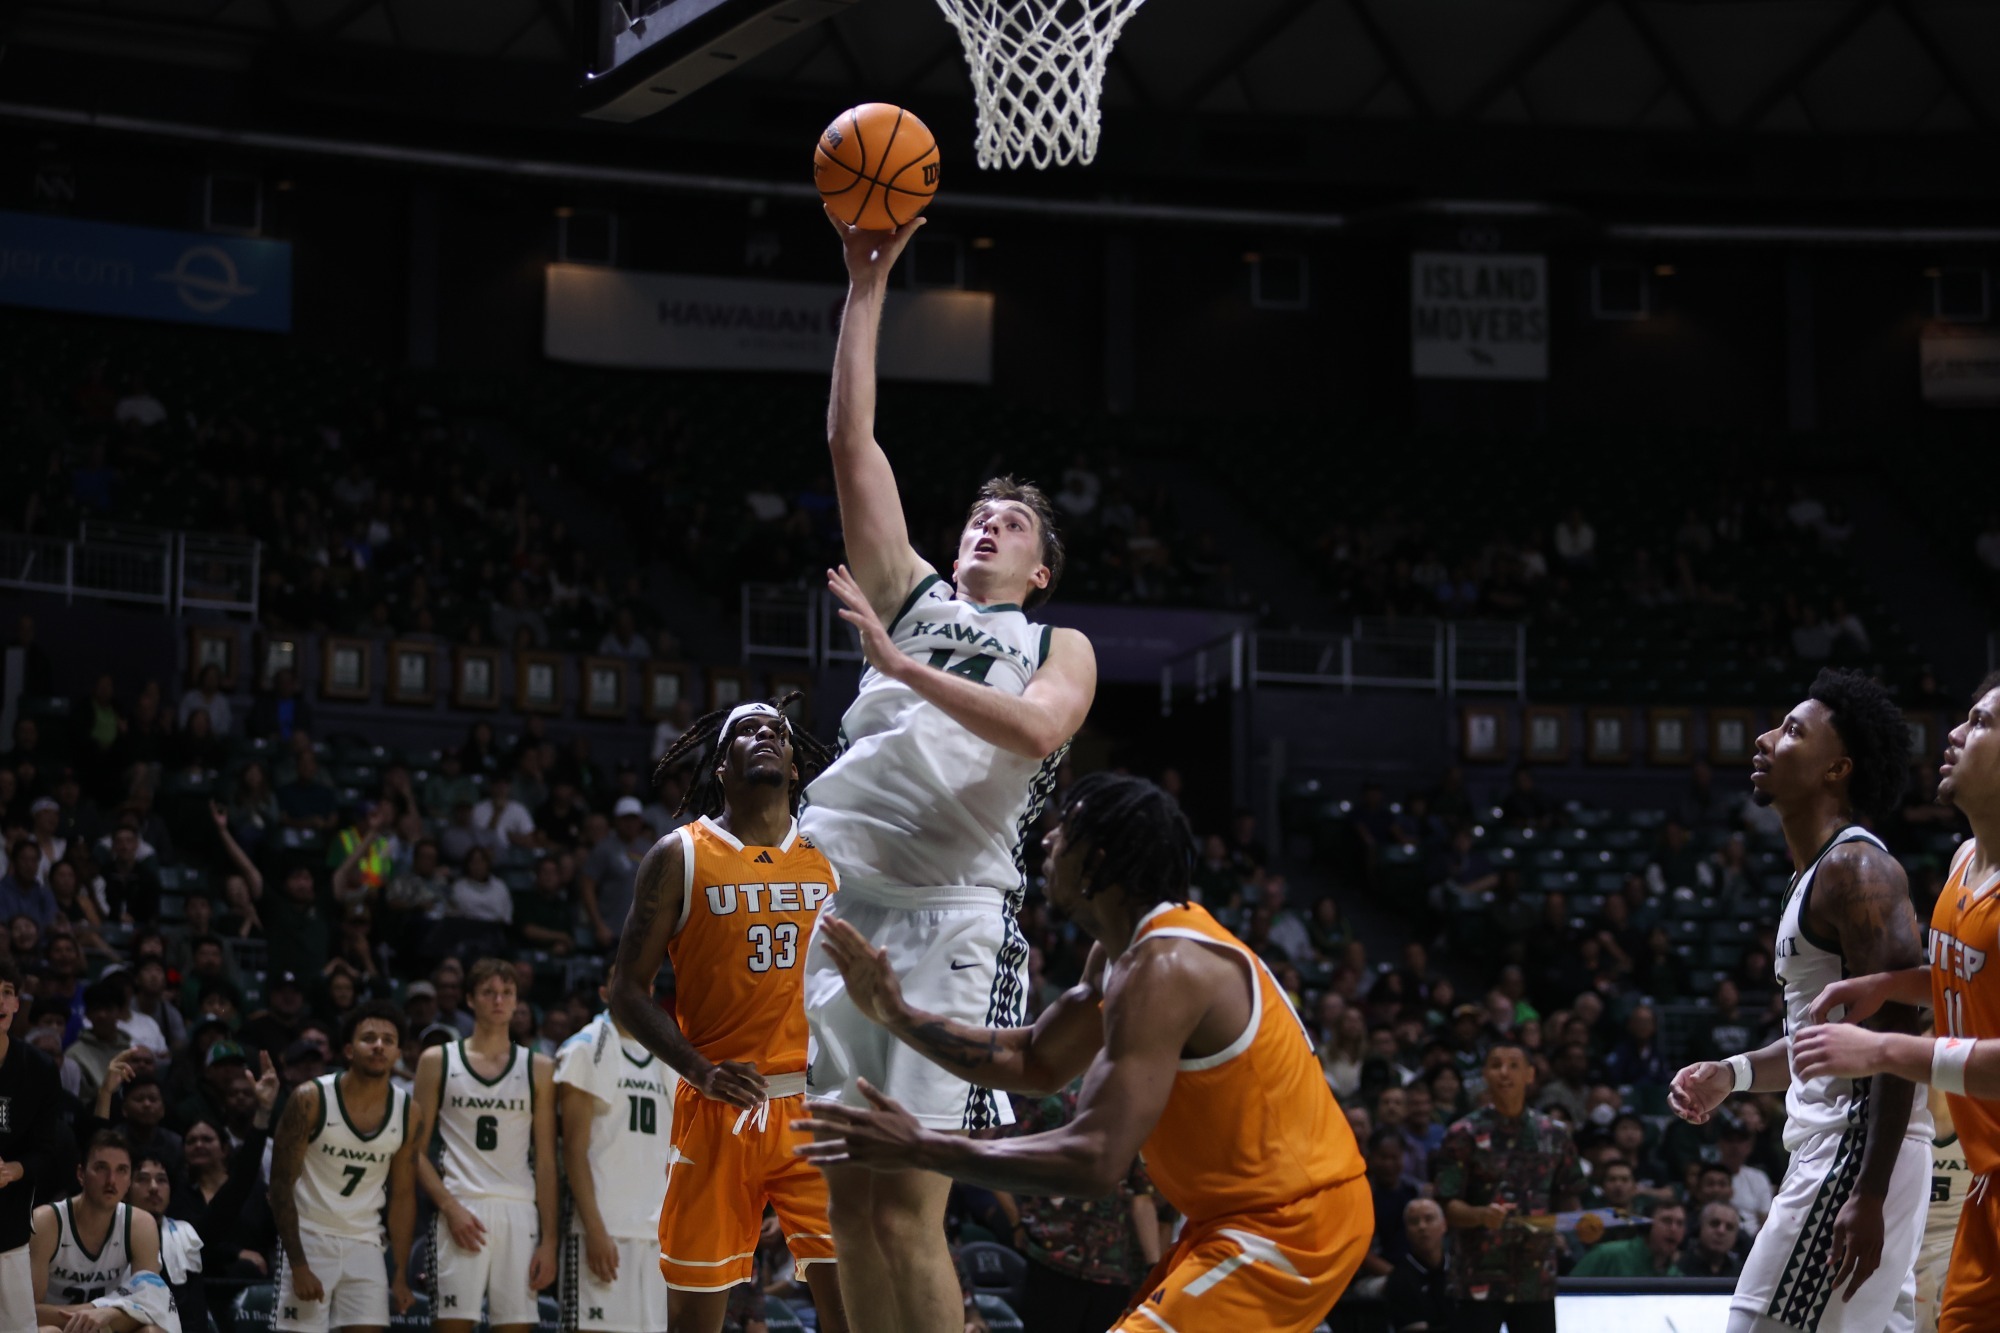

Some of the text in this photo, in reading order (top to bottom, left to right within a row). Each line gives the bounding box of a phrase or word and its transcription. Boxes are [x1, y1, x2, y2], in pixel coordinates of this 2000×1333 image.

[1423, 265, 1536, 302] ISLAND
[657, 300, 821, 334] HAWAIIAN
[1417, 305, 1544, 343] MOVERS
[928, 647, 997, 686] 14
[705, 881, 829, 916] UTEP
[747, 921, 800, 973] 33
[1928, 927, 1986, 983] UTEP
[476, 1115, 498, 1150] 6
[628, 1095, 656, 1134] 10
[340, 1165, 367, 1197] 7
